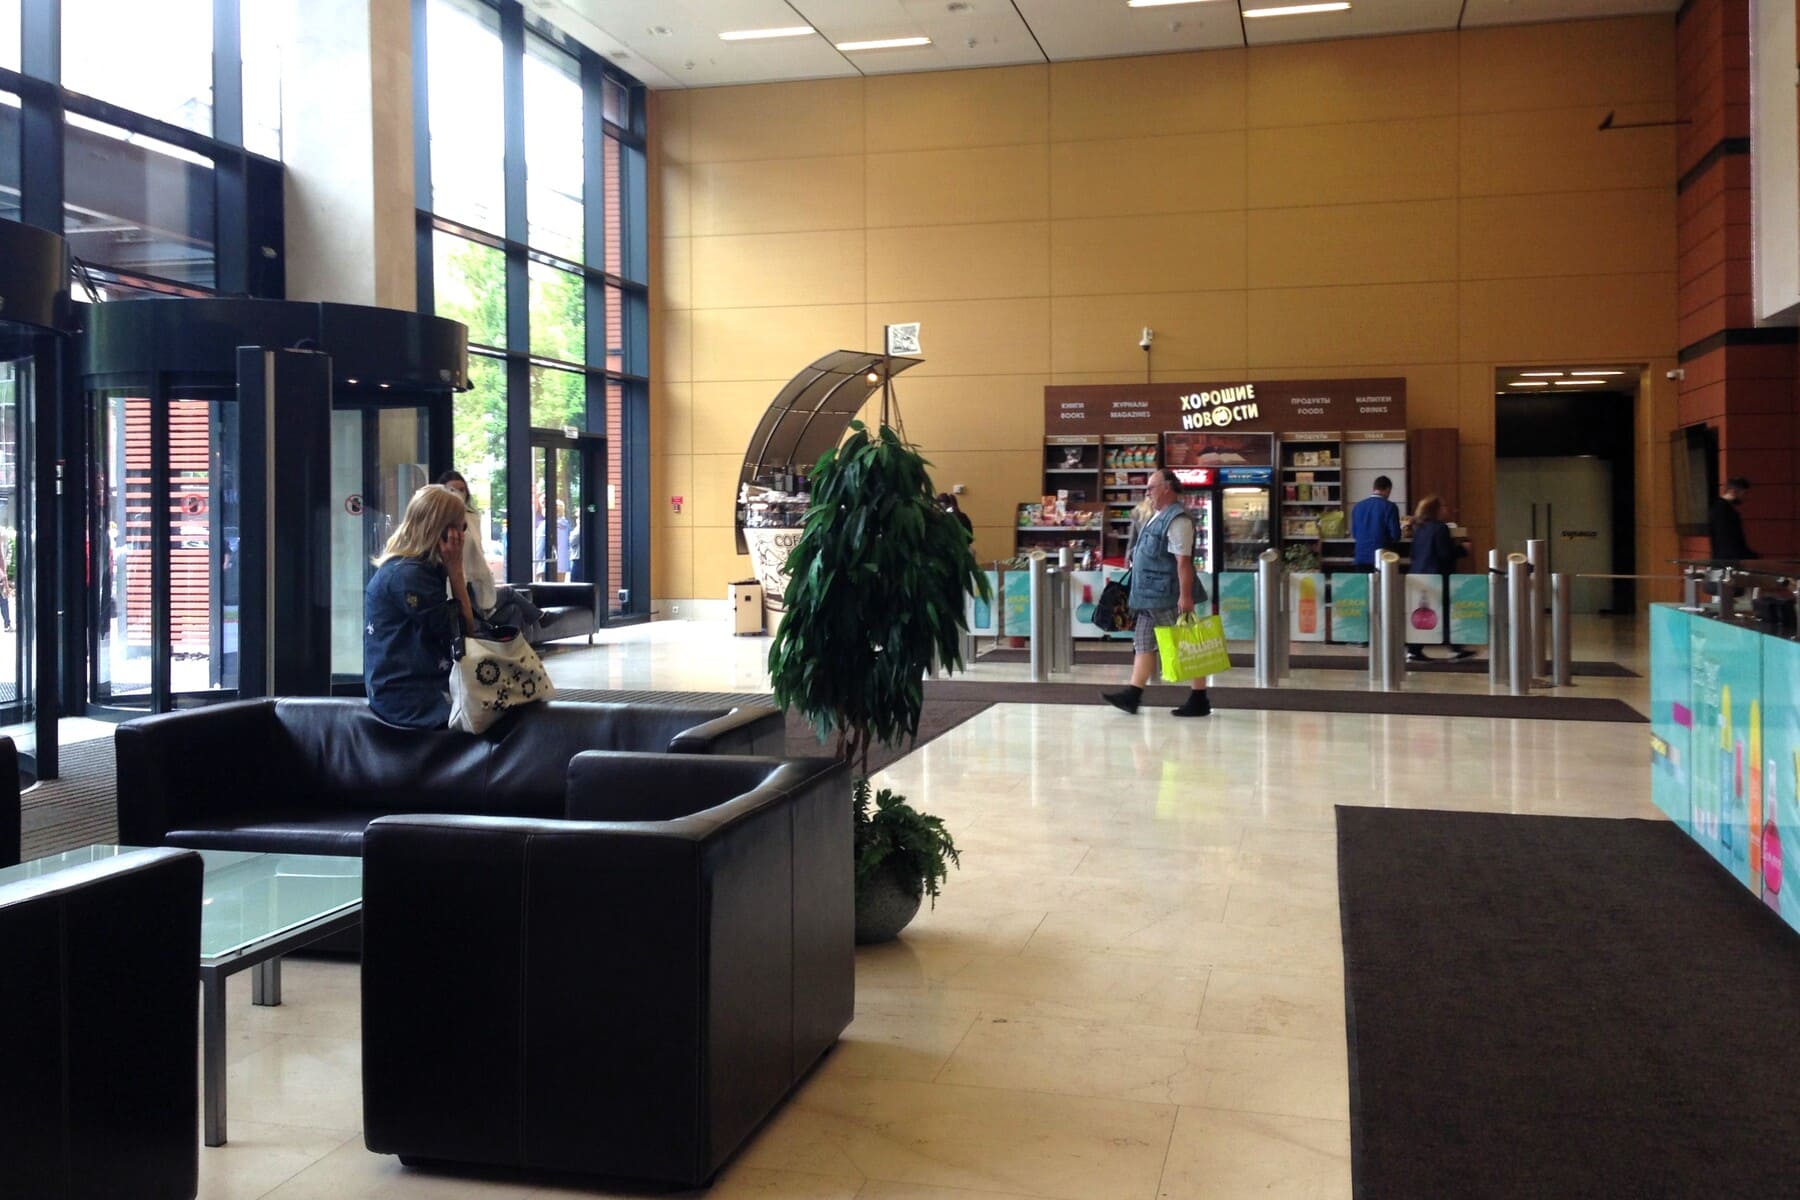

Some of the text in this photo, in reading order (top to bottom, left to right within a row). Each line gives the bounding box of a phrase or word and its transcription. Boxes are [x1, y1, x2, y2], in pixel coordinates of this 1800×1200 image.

[1180, 384, 1255, 411] ХОРОШИЕ
[1360, 406, 1388, 414] DRINKS
[1060, 412, 1085, 420] BOOKS
[1110, 411, 1151, 419] MAGAZINES
